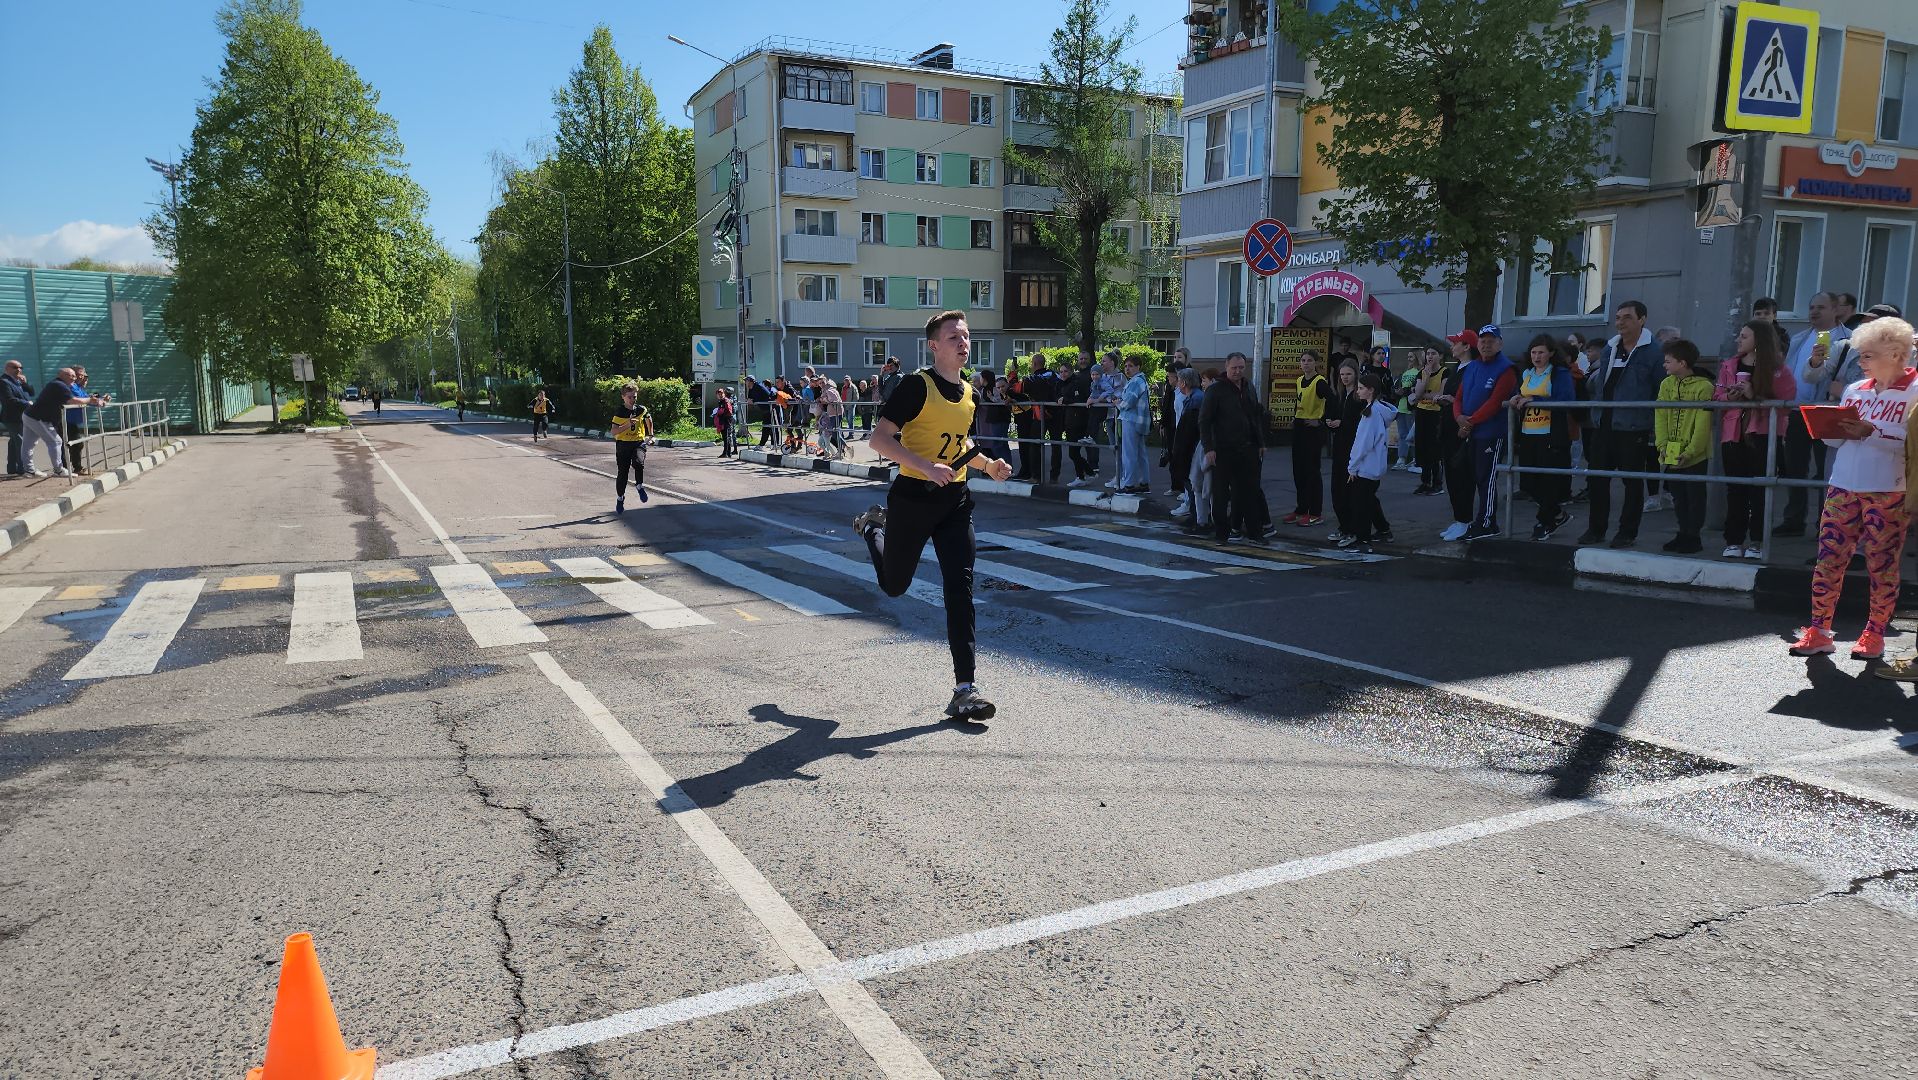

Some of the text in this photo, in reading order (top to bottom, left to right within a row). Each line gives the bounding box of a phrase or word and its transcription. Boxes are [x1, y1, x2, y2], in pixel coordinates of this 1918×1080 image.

[1798, 178, 1912, 202] КОМПЬЮТЕРЫ
[1288, 250, 1340, 267] ЛОМБАРД
[1297, 276, 1359, 301] ПРЕМЬЕР
[1273, 330, 1327, 338] РЕМОНТ:
[937, 432, 965, 460] 23
